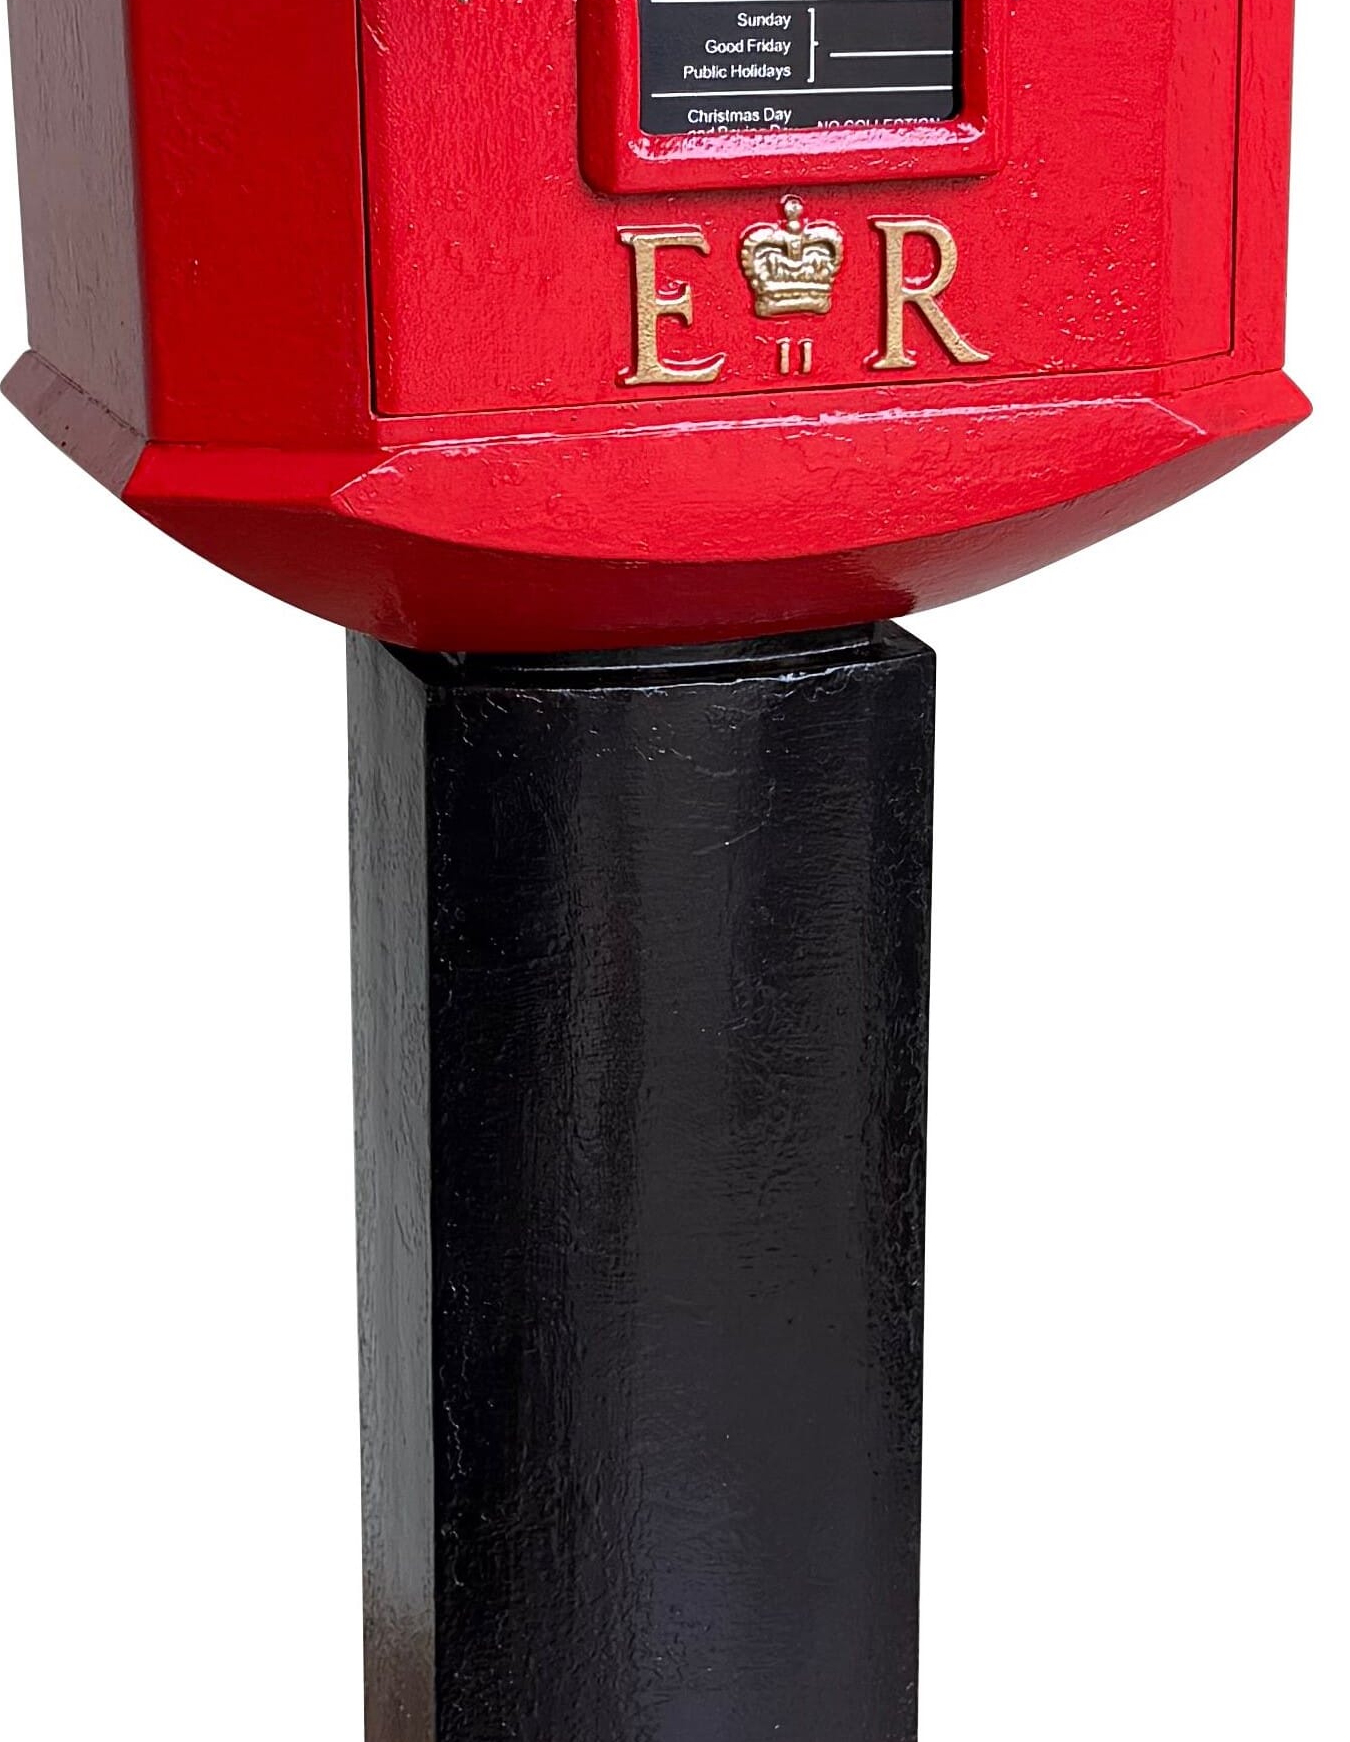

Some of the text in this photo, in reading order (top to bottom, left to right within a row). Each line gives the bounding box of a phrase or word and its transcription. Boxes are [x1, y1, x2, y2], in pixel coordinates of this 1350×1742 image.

[737, 12, 792, 30] Sunday
[704, 38, 792, 56] Good Friday
[683, 63, 792, 81] Public Holidays
[687, 106, 793, 125] Christmas Day
[616, 214, 990, 387] E R
